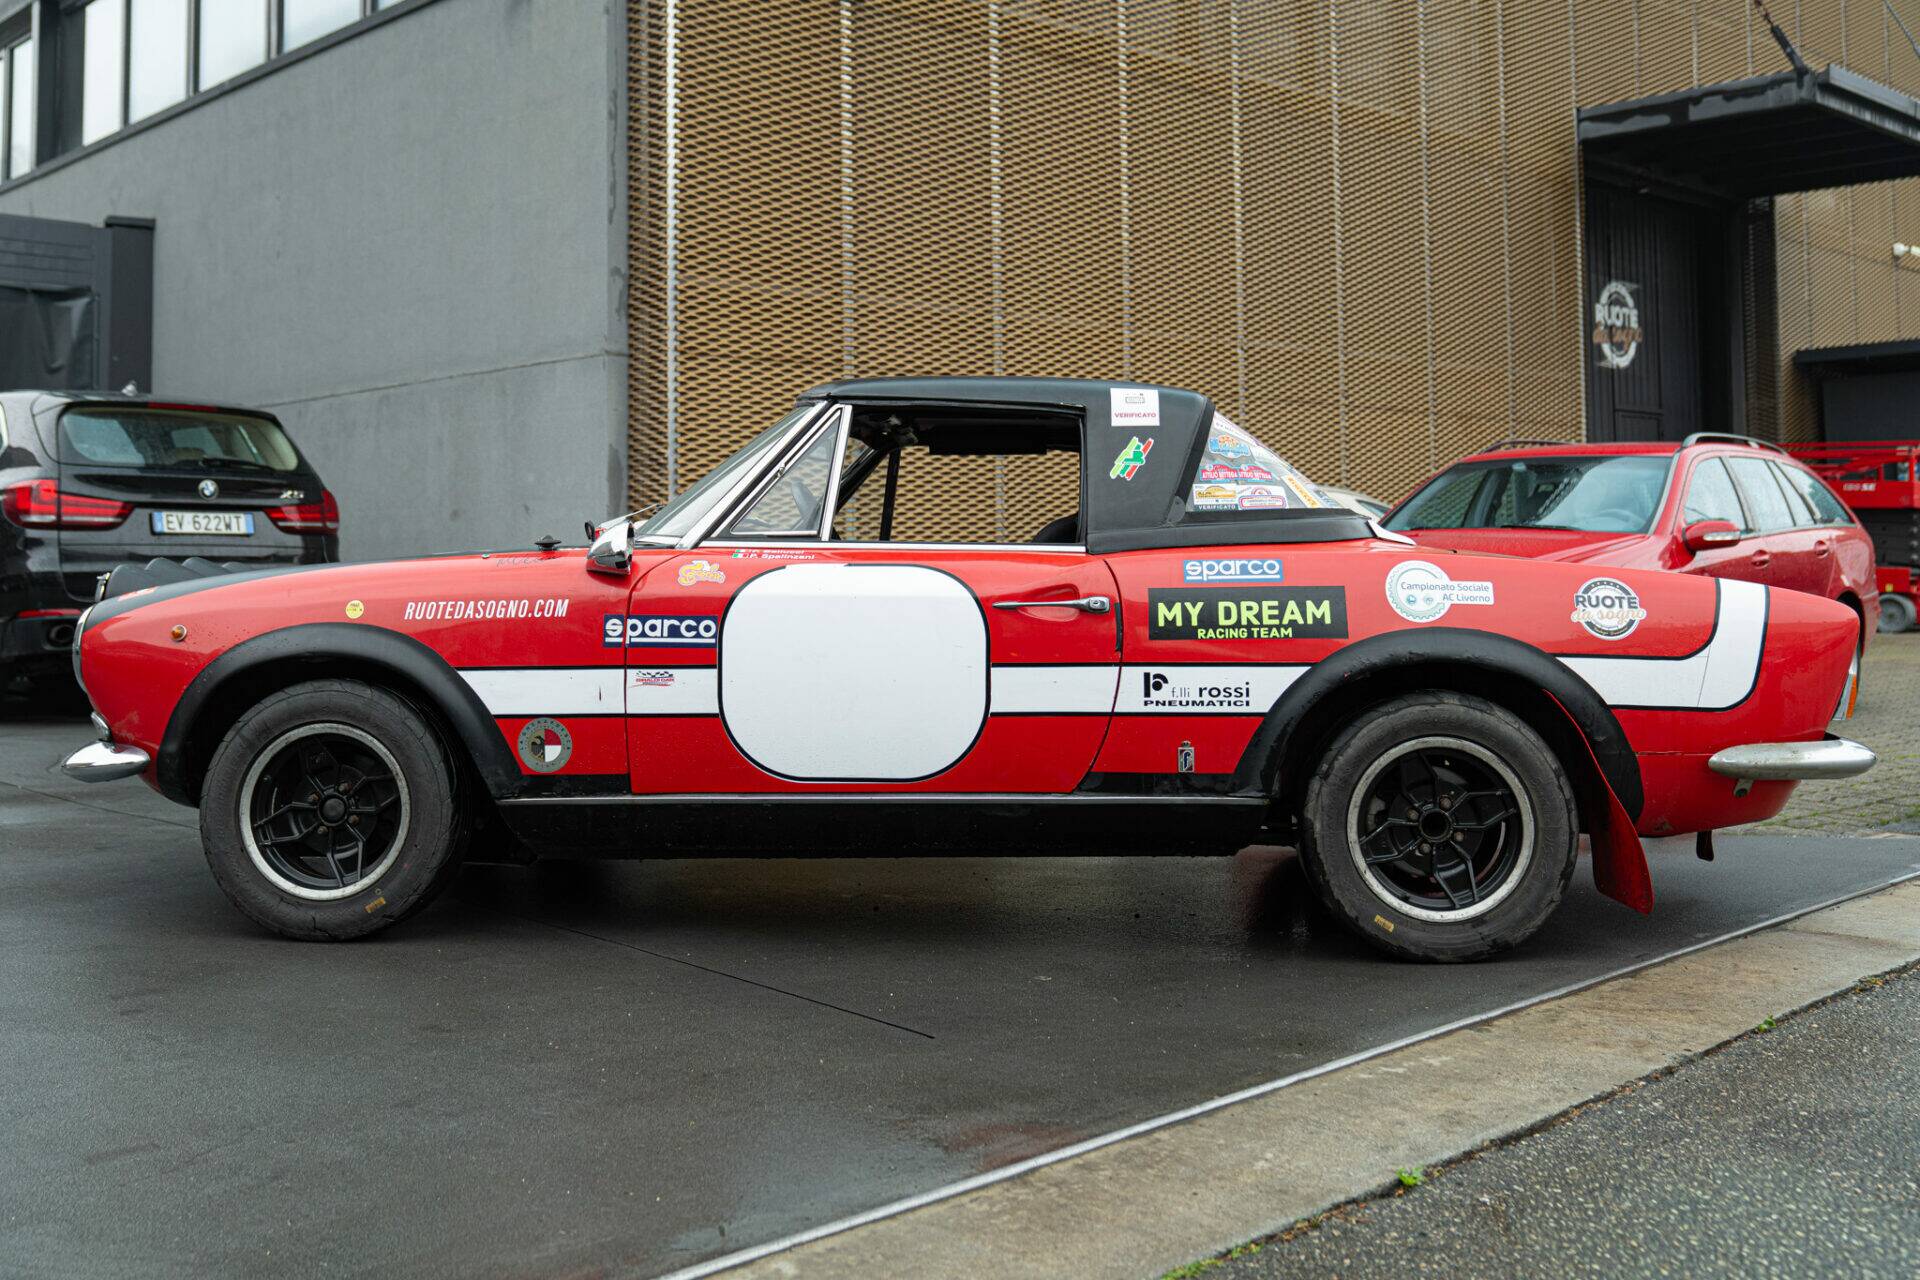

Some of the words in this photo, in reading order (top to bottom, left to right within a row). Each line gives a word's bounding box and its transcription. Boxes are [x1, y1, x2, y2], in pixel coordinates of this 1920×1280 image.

[1595, 303, 1639, 330] RUOTE
[165, 514, 183, 531] EV
[192, 515, 242, 532] 622WT
[1186, 560, 1280, 581] sparco
[1401, 582, 1455, 592] Campionato
[1457, 584, 1489, 592] Sociale
[1442, 594, 1454, 602] AC
[1456, 594, 1491, 602] Livorno
[1575, 595, 1638, 609] RUOTE
[404, 599, 569, 620] RUOTEDASOGNO.COM
[1157, 602, 1204, 627] MY
[1217, 600, 1331, 626] DREAM
[605, 618, 717, 644] sparco
[1197, 628, 1248, 639] RACING
[1250, 627, 1292, 639] TEAM
[1171, 687, 1191, 698] f.lli
[1198, 682, 1250, 698] rossi
